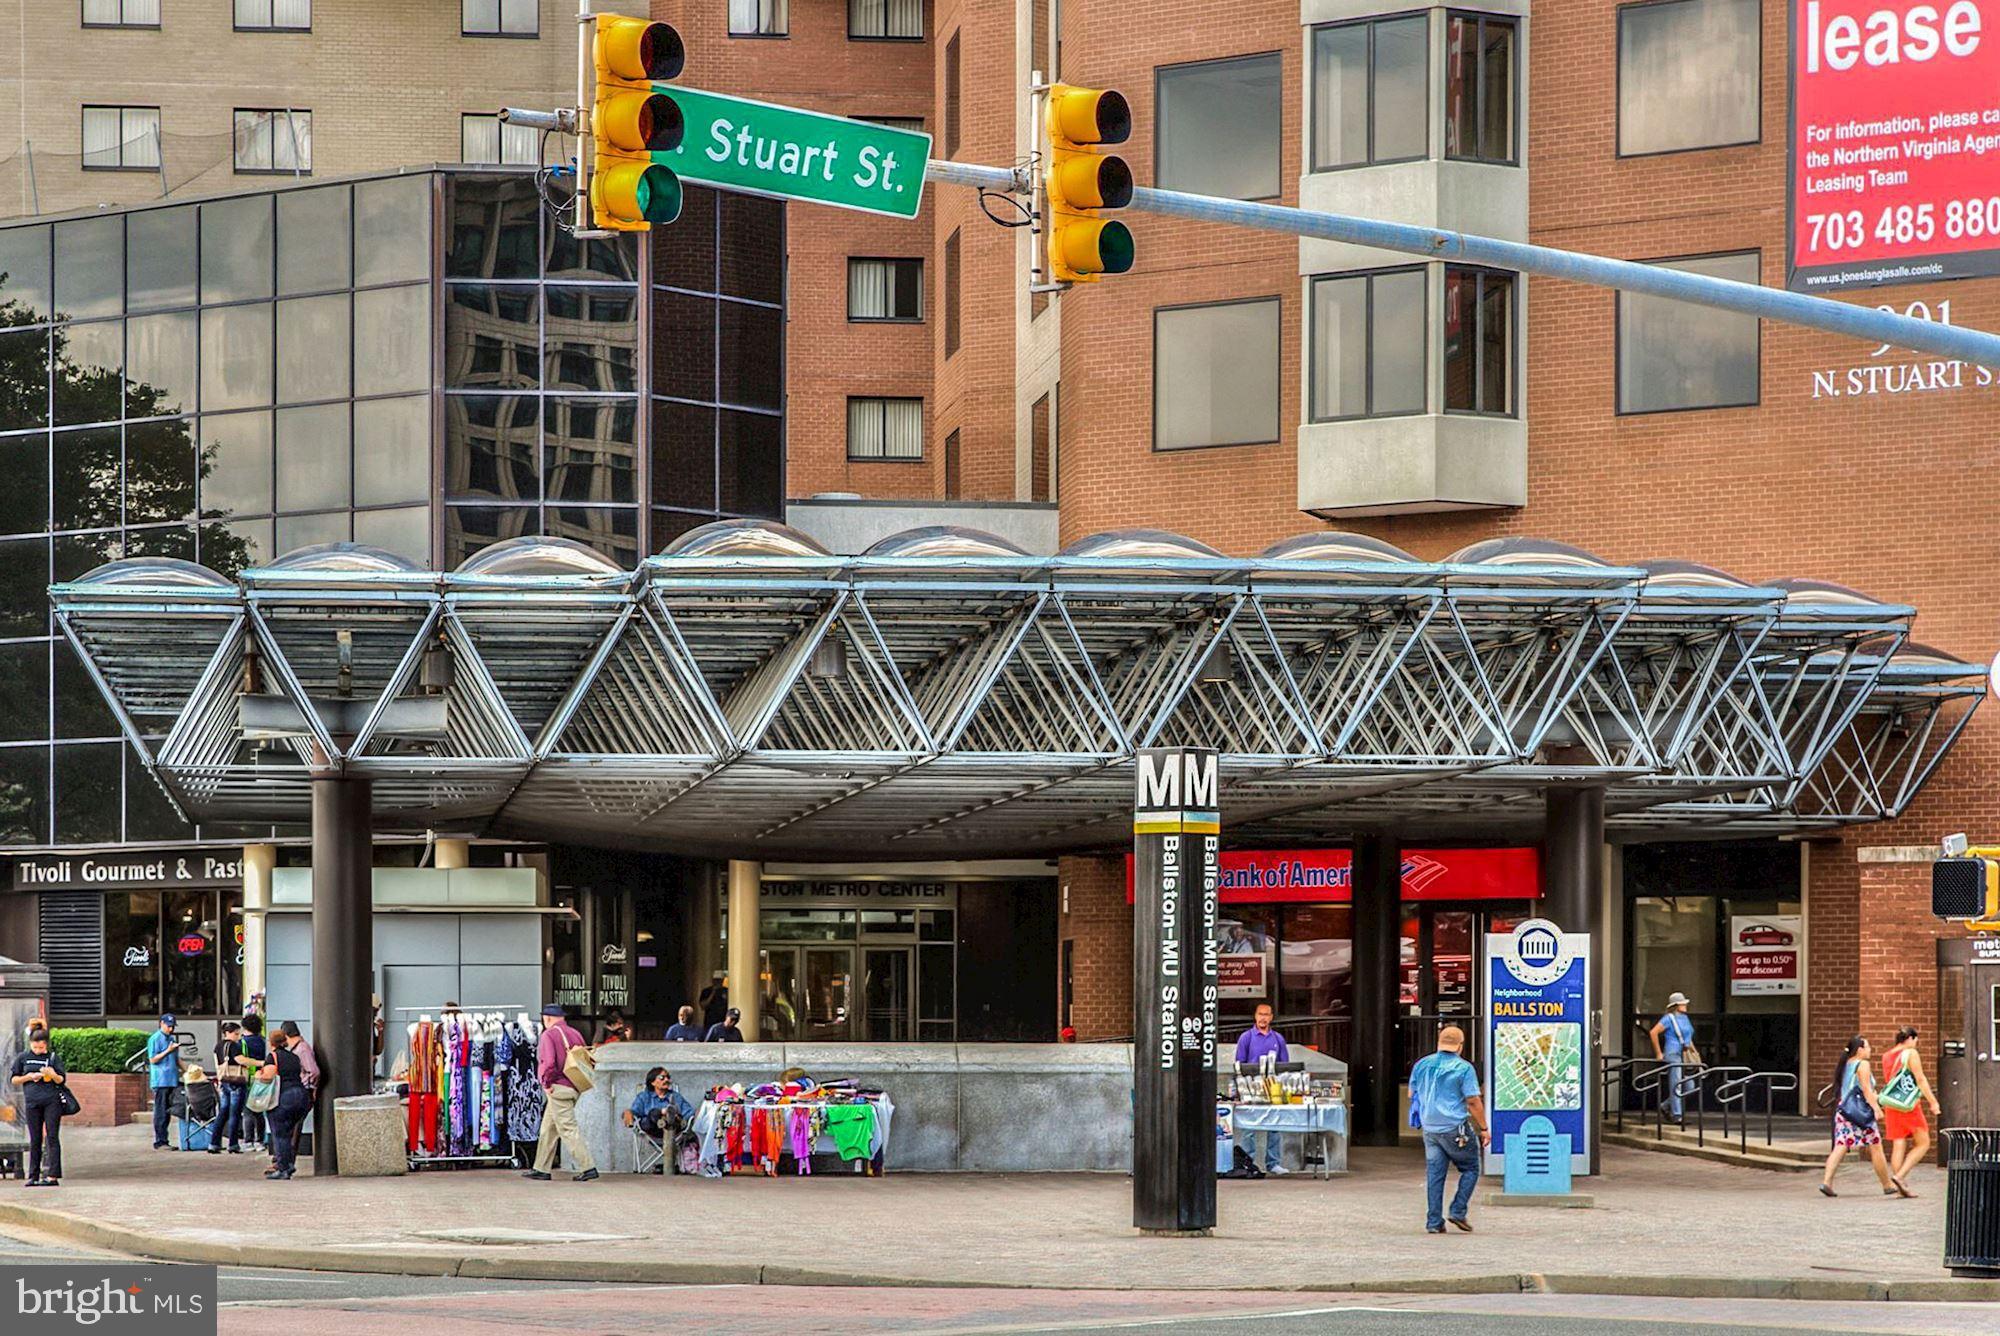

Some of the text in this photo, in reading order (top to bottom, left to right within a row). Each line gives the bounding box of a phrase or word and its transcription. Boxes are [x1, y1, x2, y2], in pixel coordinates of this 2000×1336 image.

[1806, 0, 1982, 74] lease
[1807, 109, 2000, 143] For information, please ca
[706, 118, 904, 193] Stuart St.
[1806, 149, 1830, 167] the
[1833, 144, 1899, 166] Northern
[1903, 138, 1961, 161] Virginia
[1806, 169, 1908, 194] Leasing Team
[1807, 196, 2000, 252] 703 485 880
[1812, 361, 2000, 399] N. STUART S
[1138, 754, 1180, 807] M
[1184, 754, 1218, 807] M
[20, 861, 71, 883] Tivoli
[81, 859, 165, 882] Gourmet
[175, 857, 193, 880] &
[1265, 861, 1288, 887] of
[810, 882, 871, 897] METRO
[877, 882, 946, 897] CENTER
[178, 938, 204, 952] OPEN
[1161, 836, 1180, 1069] Ballston-MU Station
[1202, 836, 1218, 1068] Ballston-MU Station
[1736, 956, 1750, 965] Get
[1751, 957, 1761, 967] up
[1763, 956, 1771, 964] to
[1736, 966, 1783, 975] rate discount
[560, 974, 585, 990] TIVOLI
[602, 974, 627, 990] TIVOLI
[1494, 989, 1543, 998] Neighborhood
[600, 990, 629, 1006] PASTRY
[1494, 1002, 1564, 1016] BALLSTON
